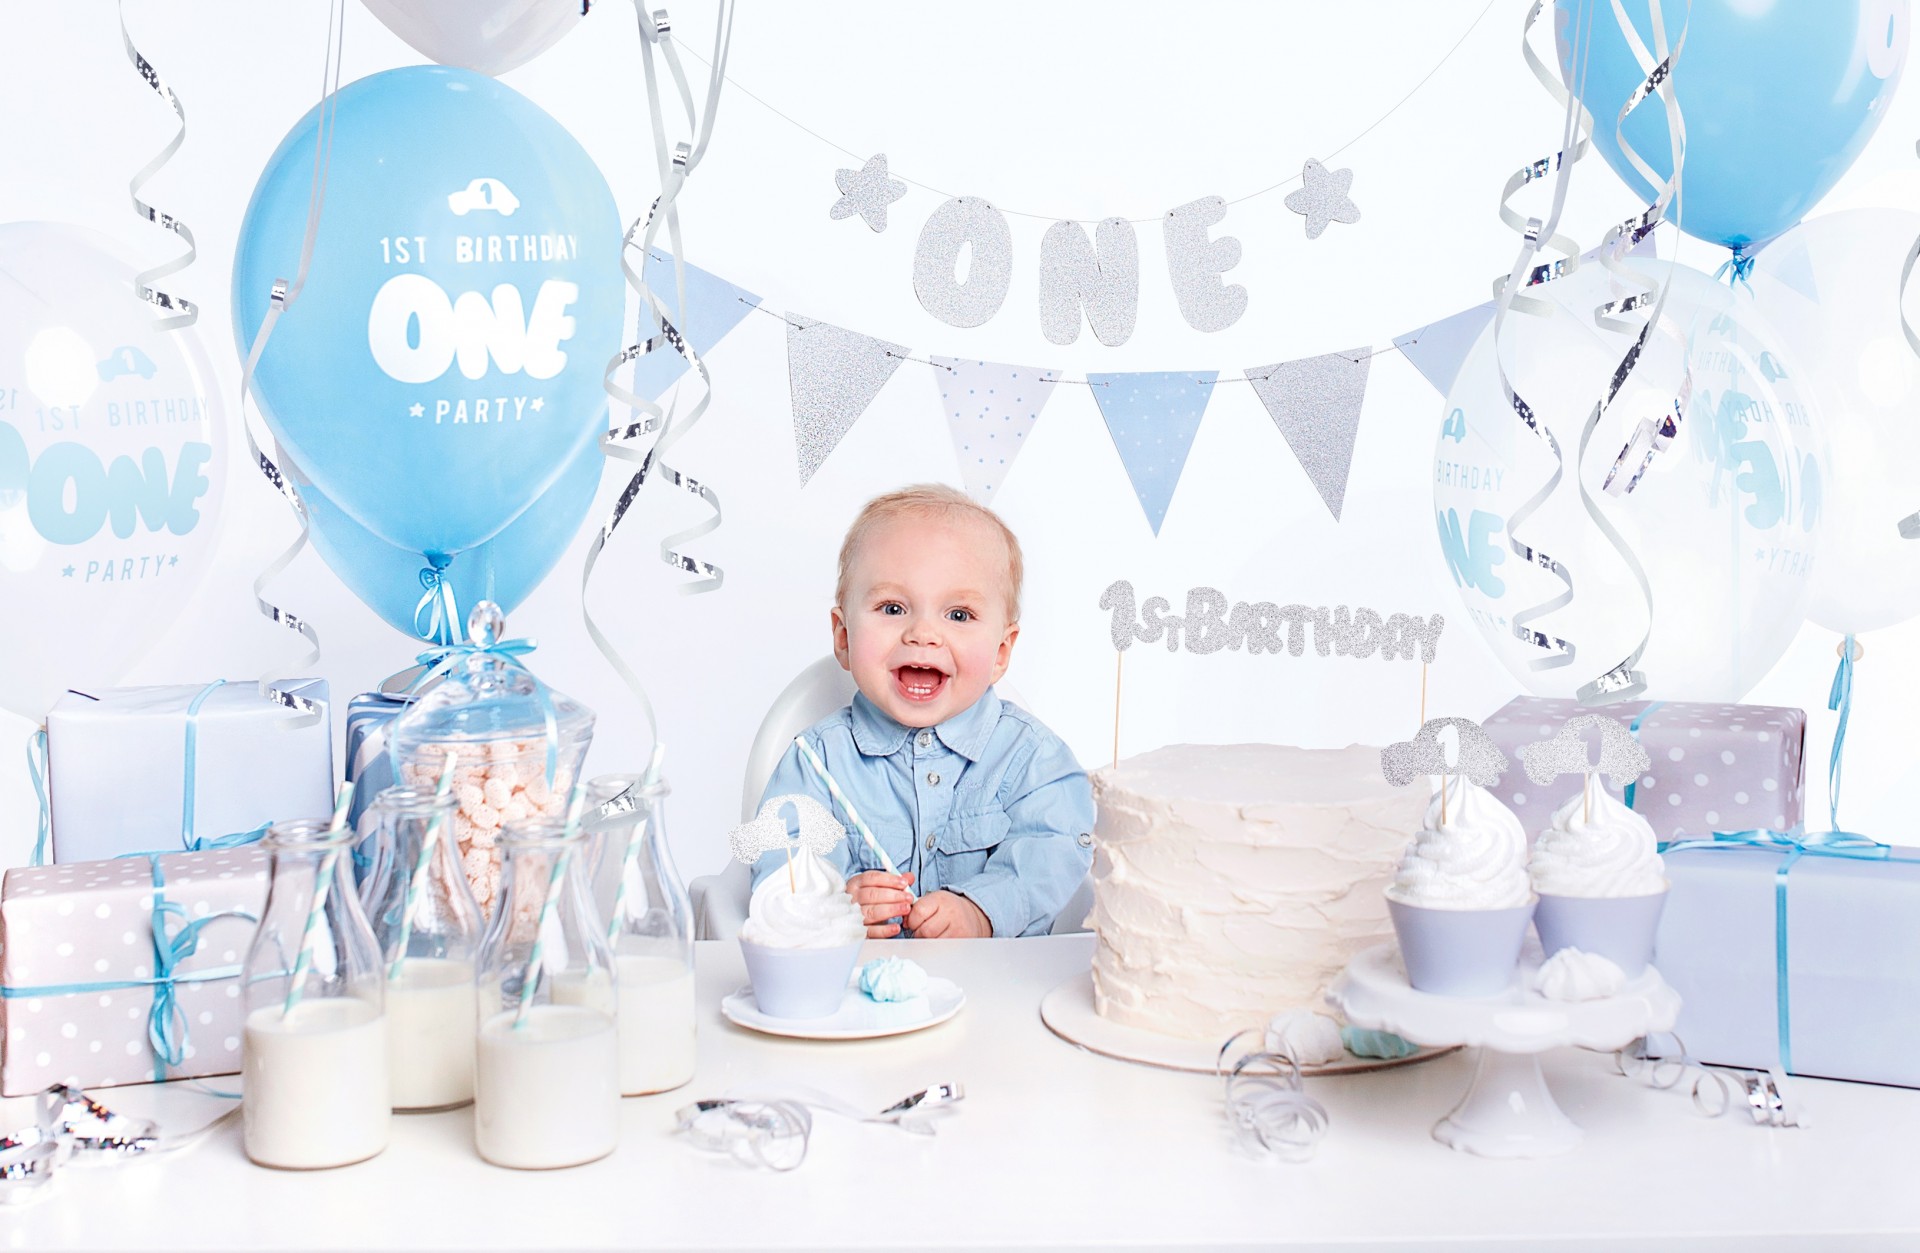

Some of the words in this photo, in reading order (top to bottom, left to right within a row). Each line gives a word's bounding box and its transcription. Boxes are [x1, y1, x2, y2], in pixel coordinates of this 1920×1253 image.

[379, 236, 428, 264] 1ST
[456, 234, 578, 263] BIRTHDAY
[913, 195, 1249, 348] ONE
[368, 273, 580, 384] ONE
[35, 404, 81, 432] 1ST
[108, 397, 209, 427] BIRTHDAY
[435, 396, 528, 424] PARTY
[27, 441, 212, 546] ONE
[1437, 460, 1505, 492] BIRTHDAY
[85, 554, 166, 583] PARTY
[1438, 507, 1506, 599] NE
